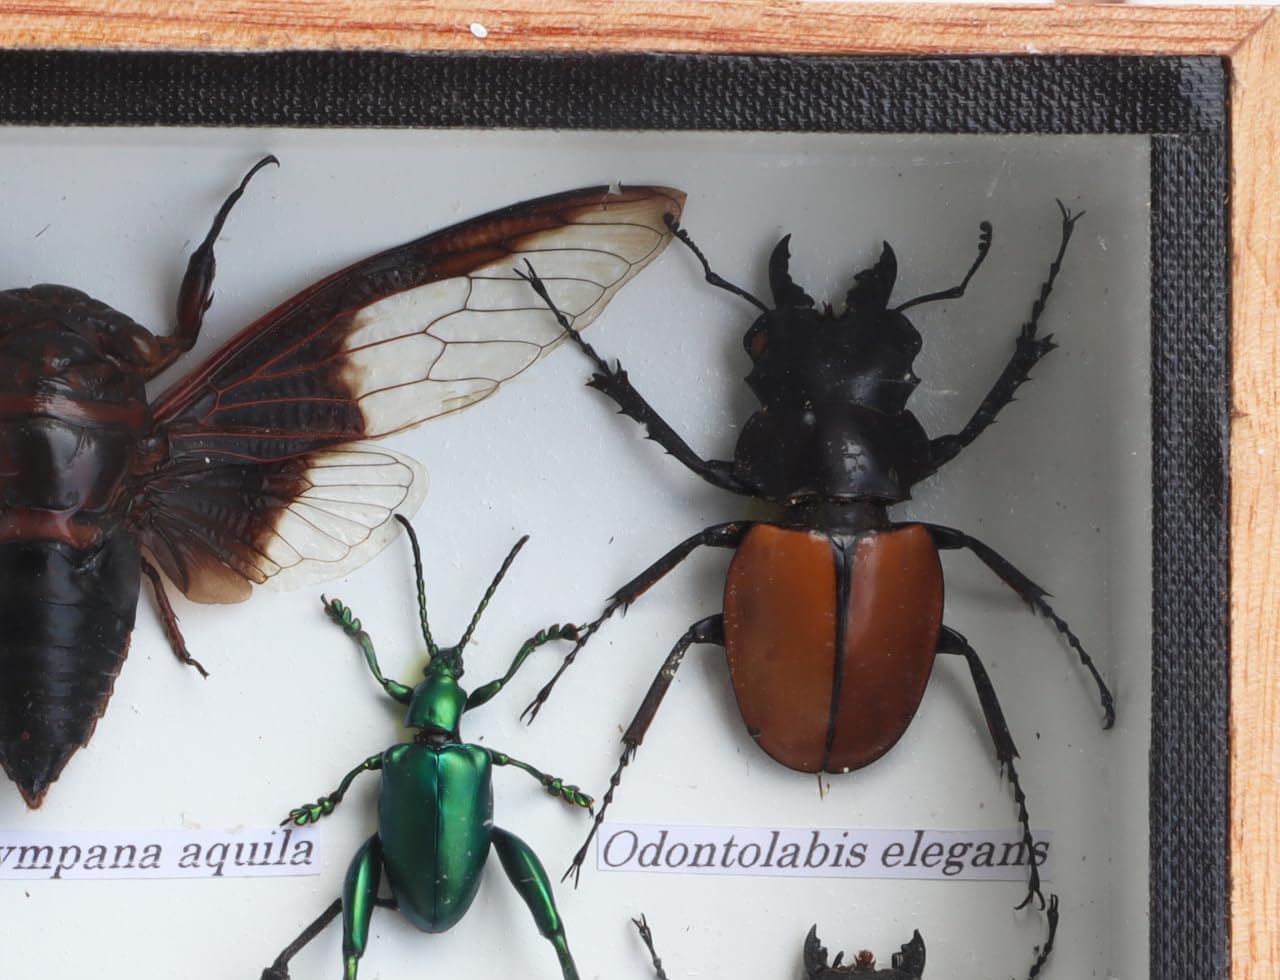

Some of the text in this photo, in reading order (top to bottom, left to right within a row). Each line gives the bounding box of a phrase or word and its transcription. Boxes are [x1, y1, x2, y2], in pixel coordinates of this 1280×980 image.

[178, 829, 314, 876] aquila
[603, 829, 1050, 875] Odontolabis elegans
